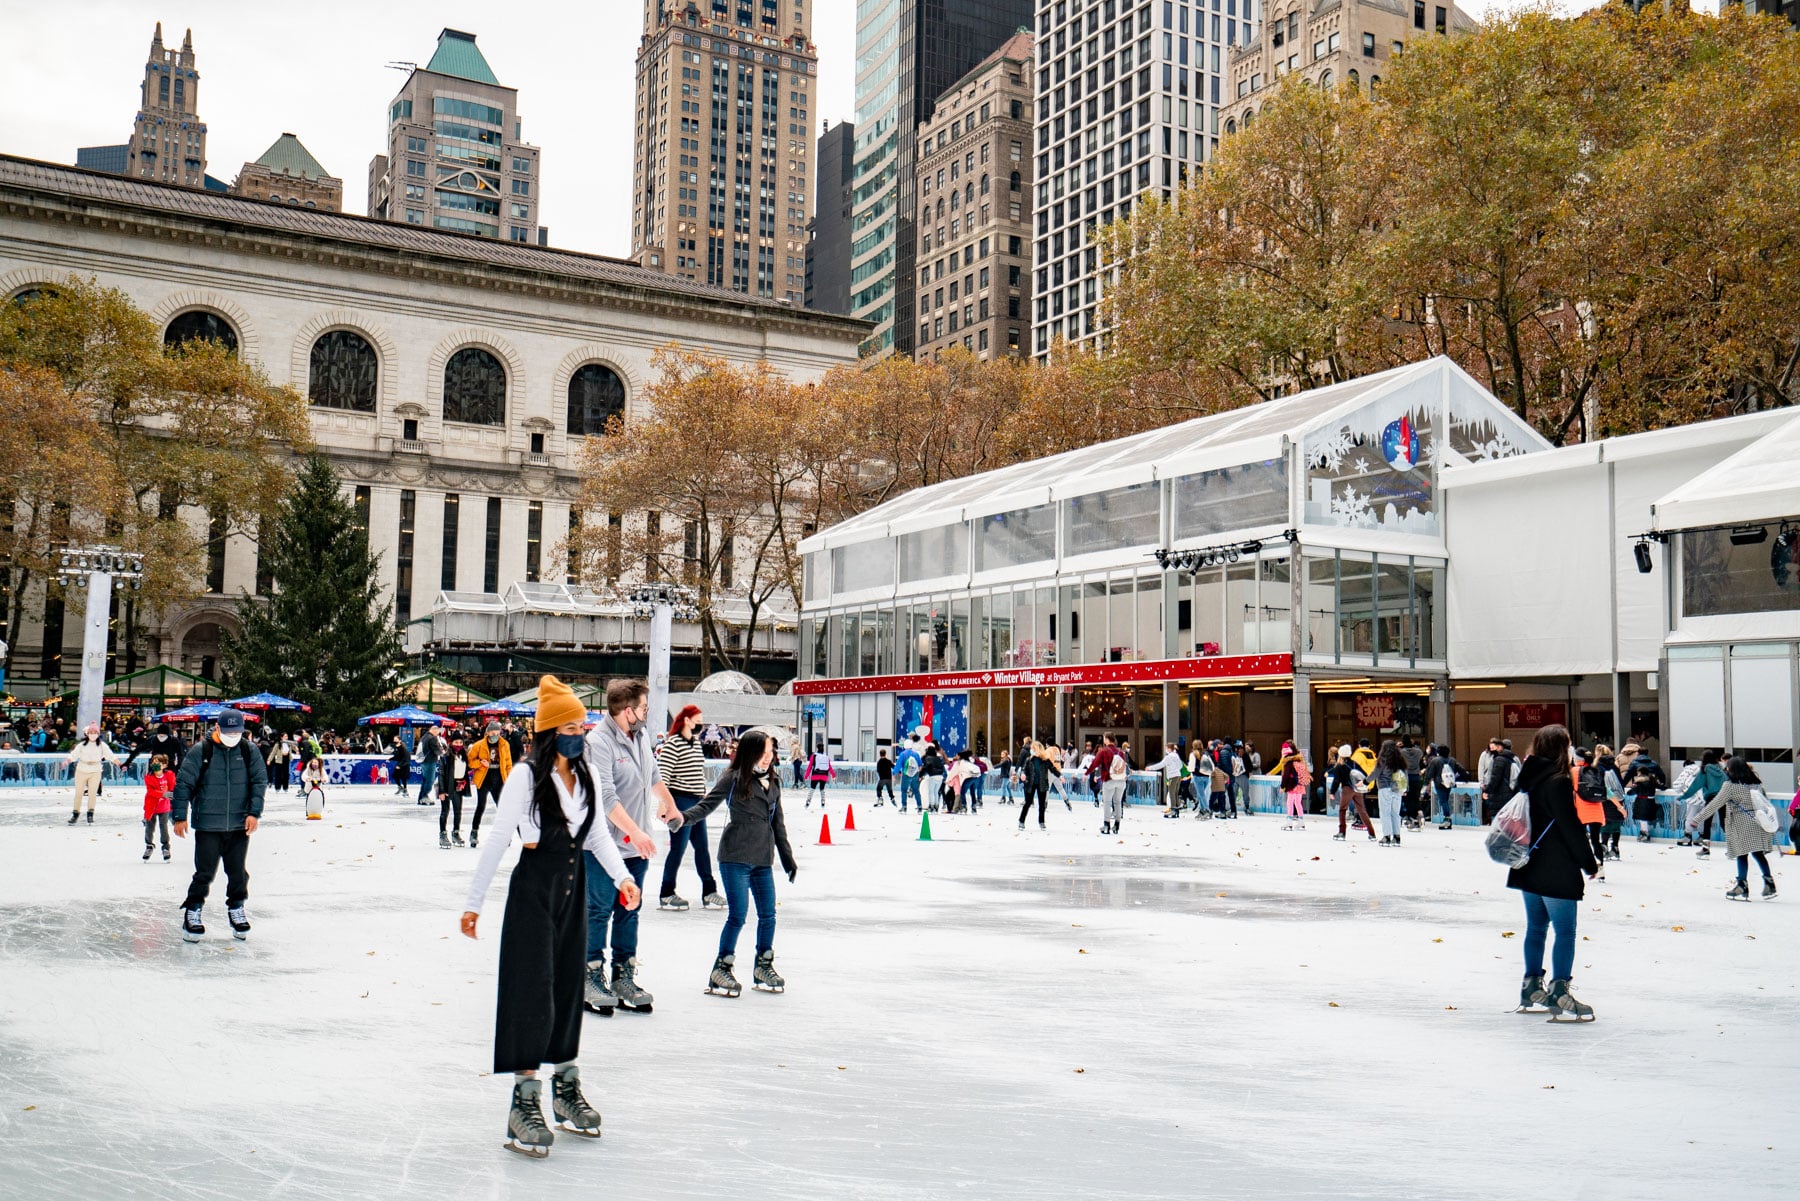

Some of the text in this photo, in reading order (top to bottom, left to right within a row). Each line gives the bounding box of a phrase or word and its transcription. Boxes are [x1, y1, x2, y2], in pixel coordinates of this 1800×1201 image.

[938, 678, 951, 686] BANK
[959, 677, 980, 685] AMERICA
[994, 673, 1018, 684] Winter
[1020, 671, 1045, 685] Village
[1047, 674, 1053, 682] at
[1053, 673, 1070, 684] Bryant
[1362, 706, 1387, 718] EXIT
